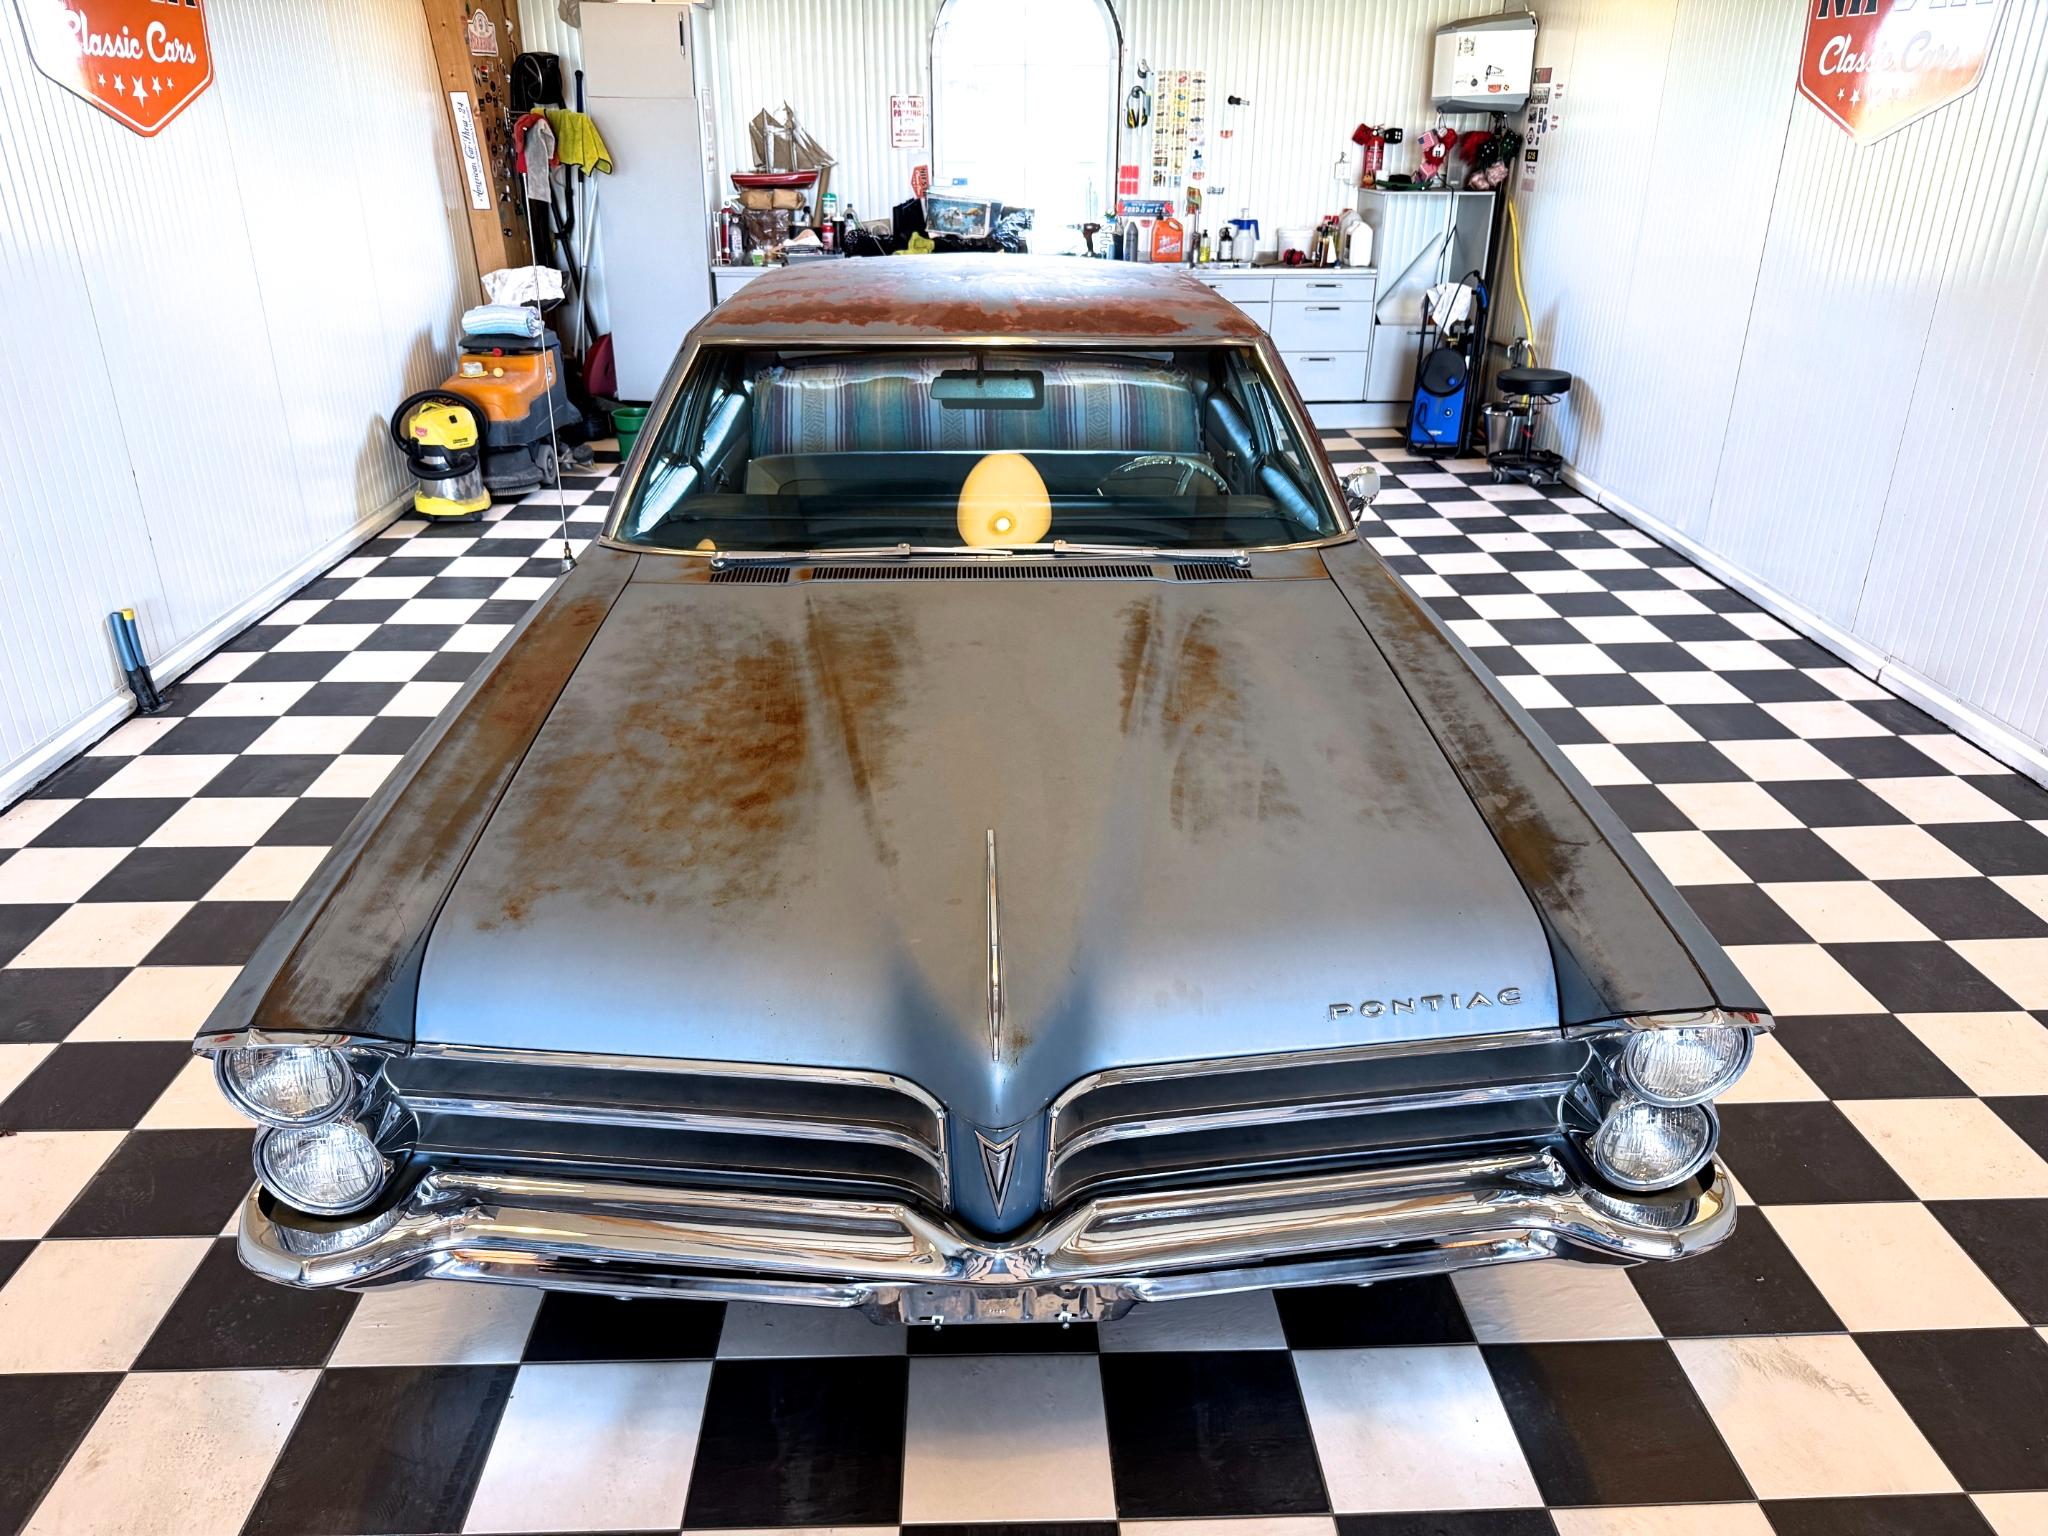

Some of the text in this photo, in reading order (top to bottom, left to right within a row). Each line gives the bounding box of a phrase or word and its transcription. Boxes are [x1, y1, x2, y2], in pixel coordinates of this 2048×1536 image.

[145, 20, 197, 64] Cars
[1818, 30, 1961, 76] Classic Cars
[464, 142, 475, 159] Car
[471, 162, 484, 202] American
[1329, 987, 1523, 1021] PONTIAC
